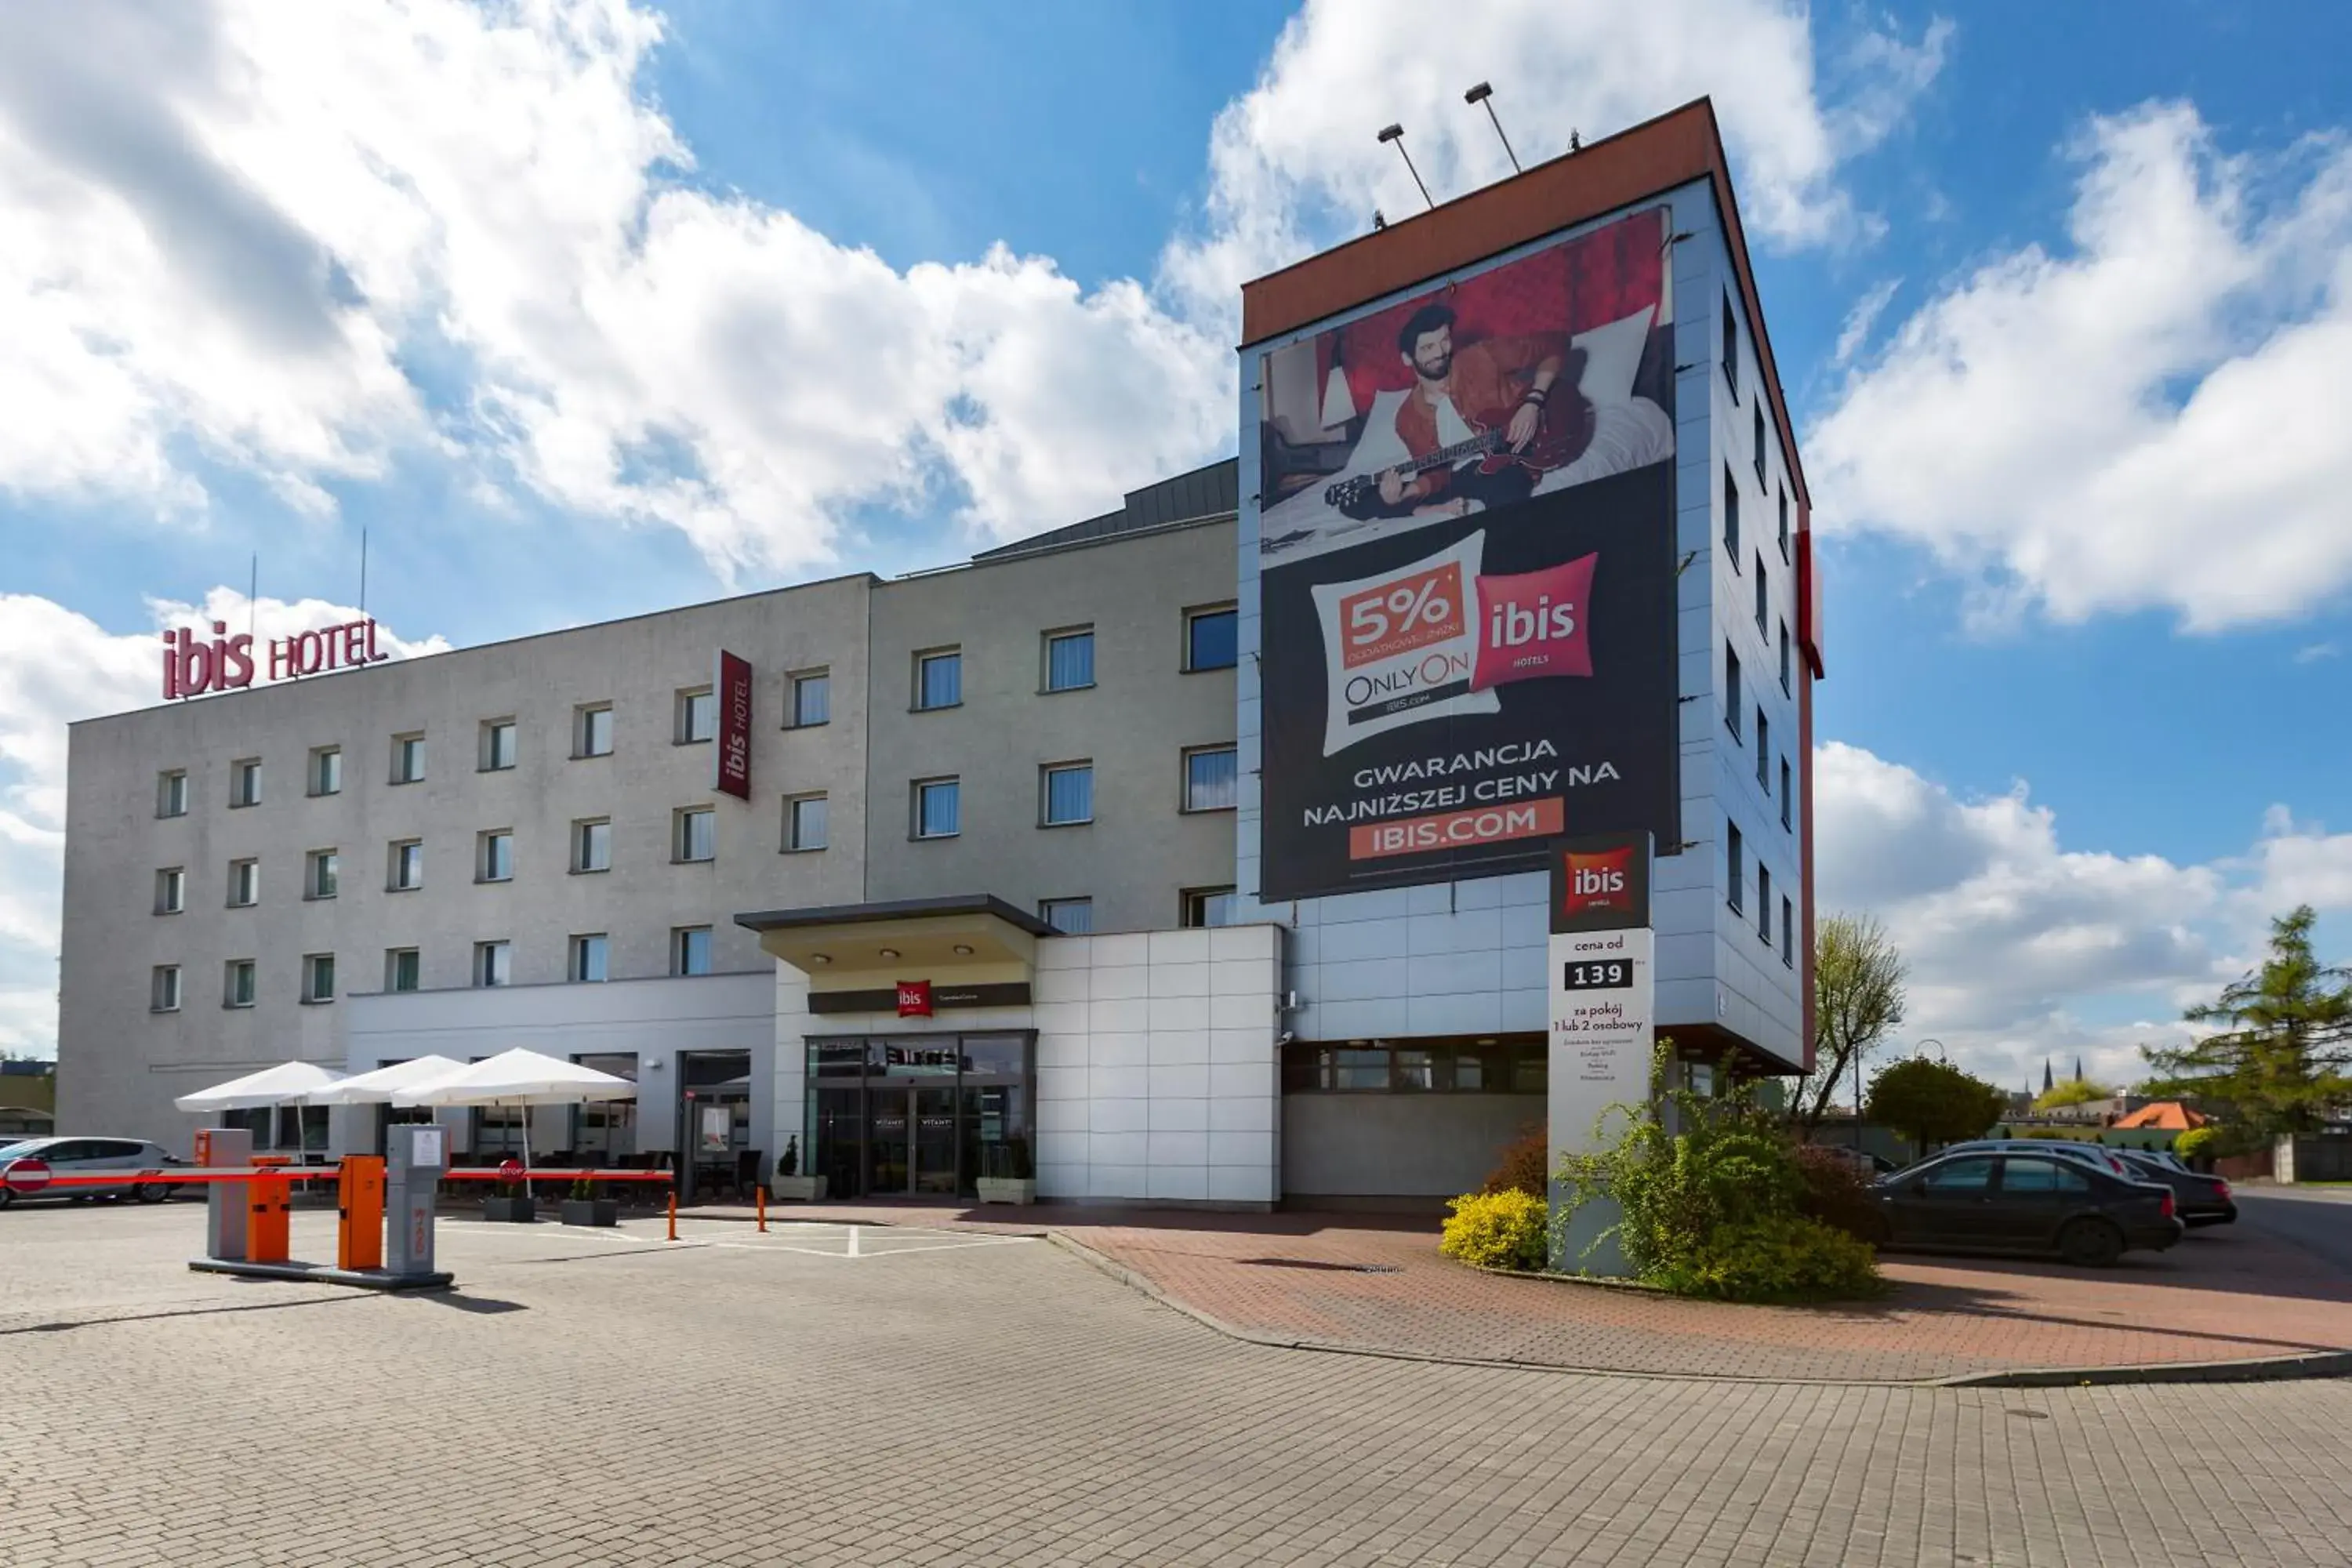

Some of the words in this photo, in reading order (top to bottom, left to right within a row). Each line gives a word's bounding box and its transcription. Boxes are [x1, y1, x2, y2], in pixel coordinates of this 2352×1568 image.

[1492, 595, 1574, 648] ibis
[163, 620, 254, 699] ibis
[270, 618, 389, 681] HOTEL
[1513, 654, 1549, 667] HOTELS
[735, 678, 748, 730] HOTEL
[725, 732, 746, 779] ibis
[1354, 739, 1558, 788] GWARANCJA
[1304, 785, 1466, 827] NAJNIŻSZEJ
[1474, 770, 1559, 800] CENY
[1569, 761, 1621, 786] NA
[1374, 808, 1536, 851] IBIS.COM
[1575, 866, 1624, 895] ibis
[1574, 941, 1603, 951] cena
[1606, 934, 1624, 949] od
[1574, 964, 1622, 985] 139
[898, 990, 921, 1004] ibis
[1589, 1001, 1622, 1018] pokój
[1554, 1022, 1559, 1032] 1
[1563, 1019, 1578, 1032] lub
[1582, 1021, 1590, 1031] 2
[1592, 1018, 1643, 1033] osobowy
[500, 1167, 523, 1176] STOP
